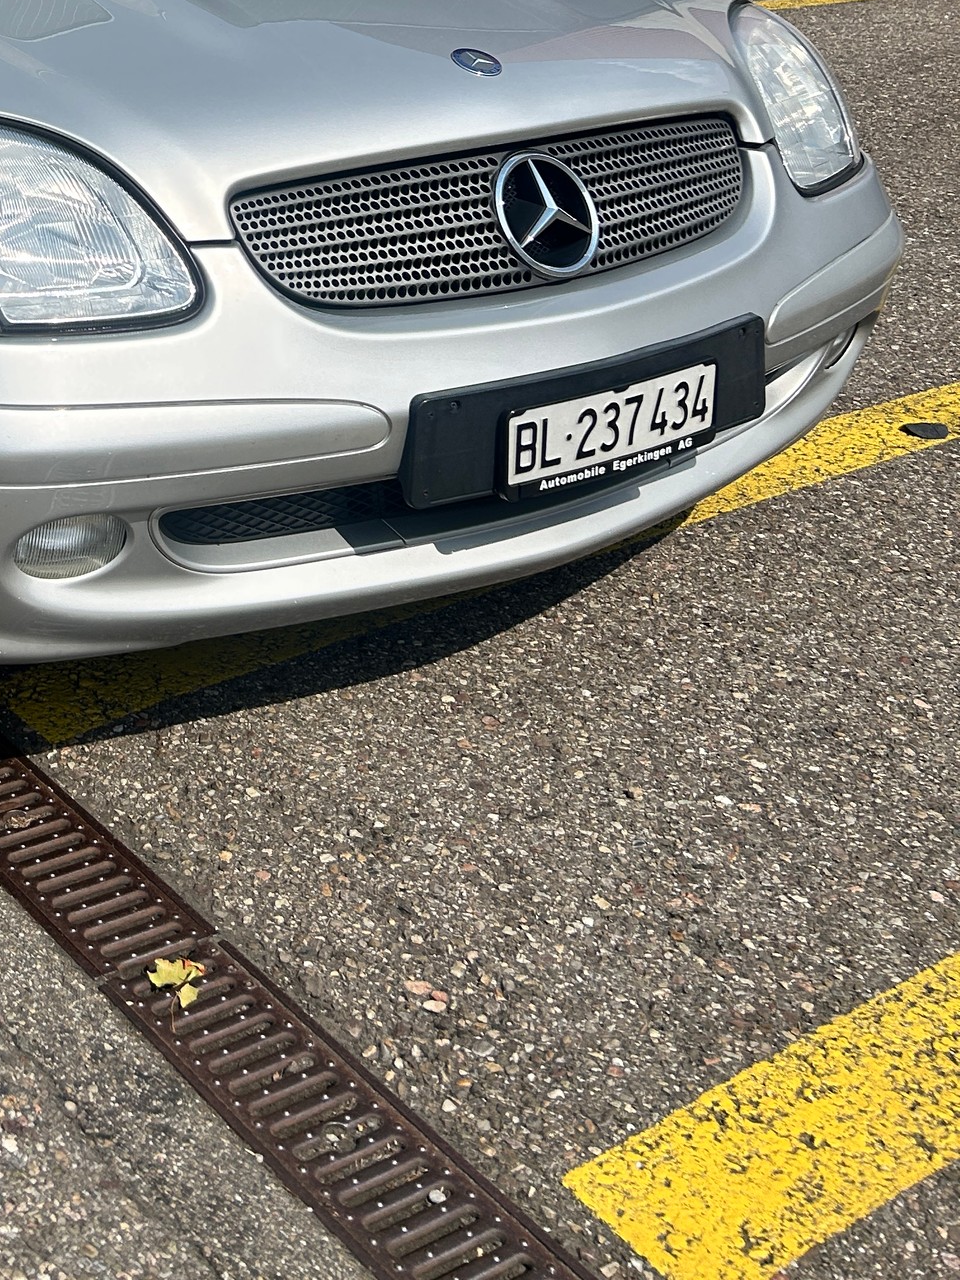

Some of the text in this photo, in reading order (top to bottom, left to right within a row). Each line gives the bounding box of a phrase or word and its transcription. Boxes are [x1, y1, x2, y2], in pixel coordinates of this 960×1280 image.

[539, 437, 693, 491] Automobile Egerkingen AG
